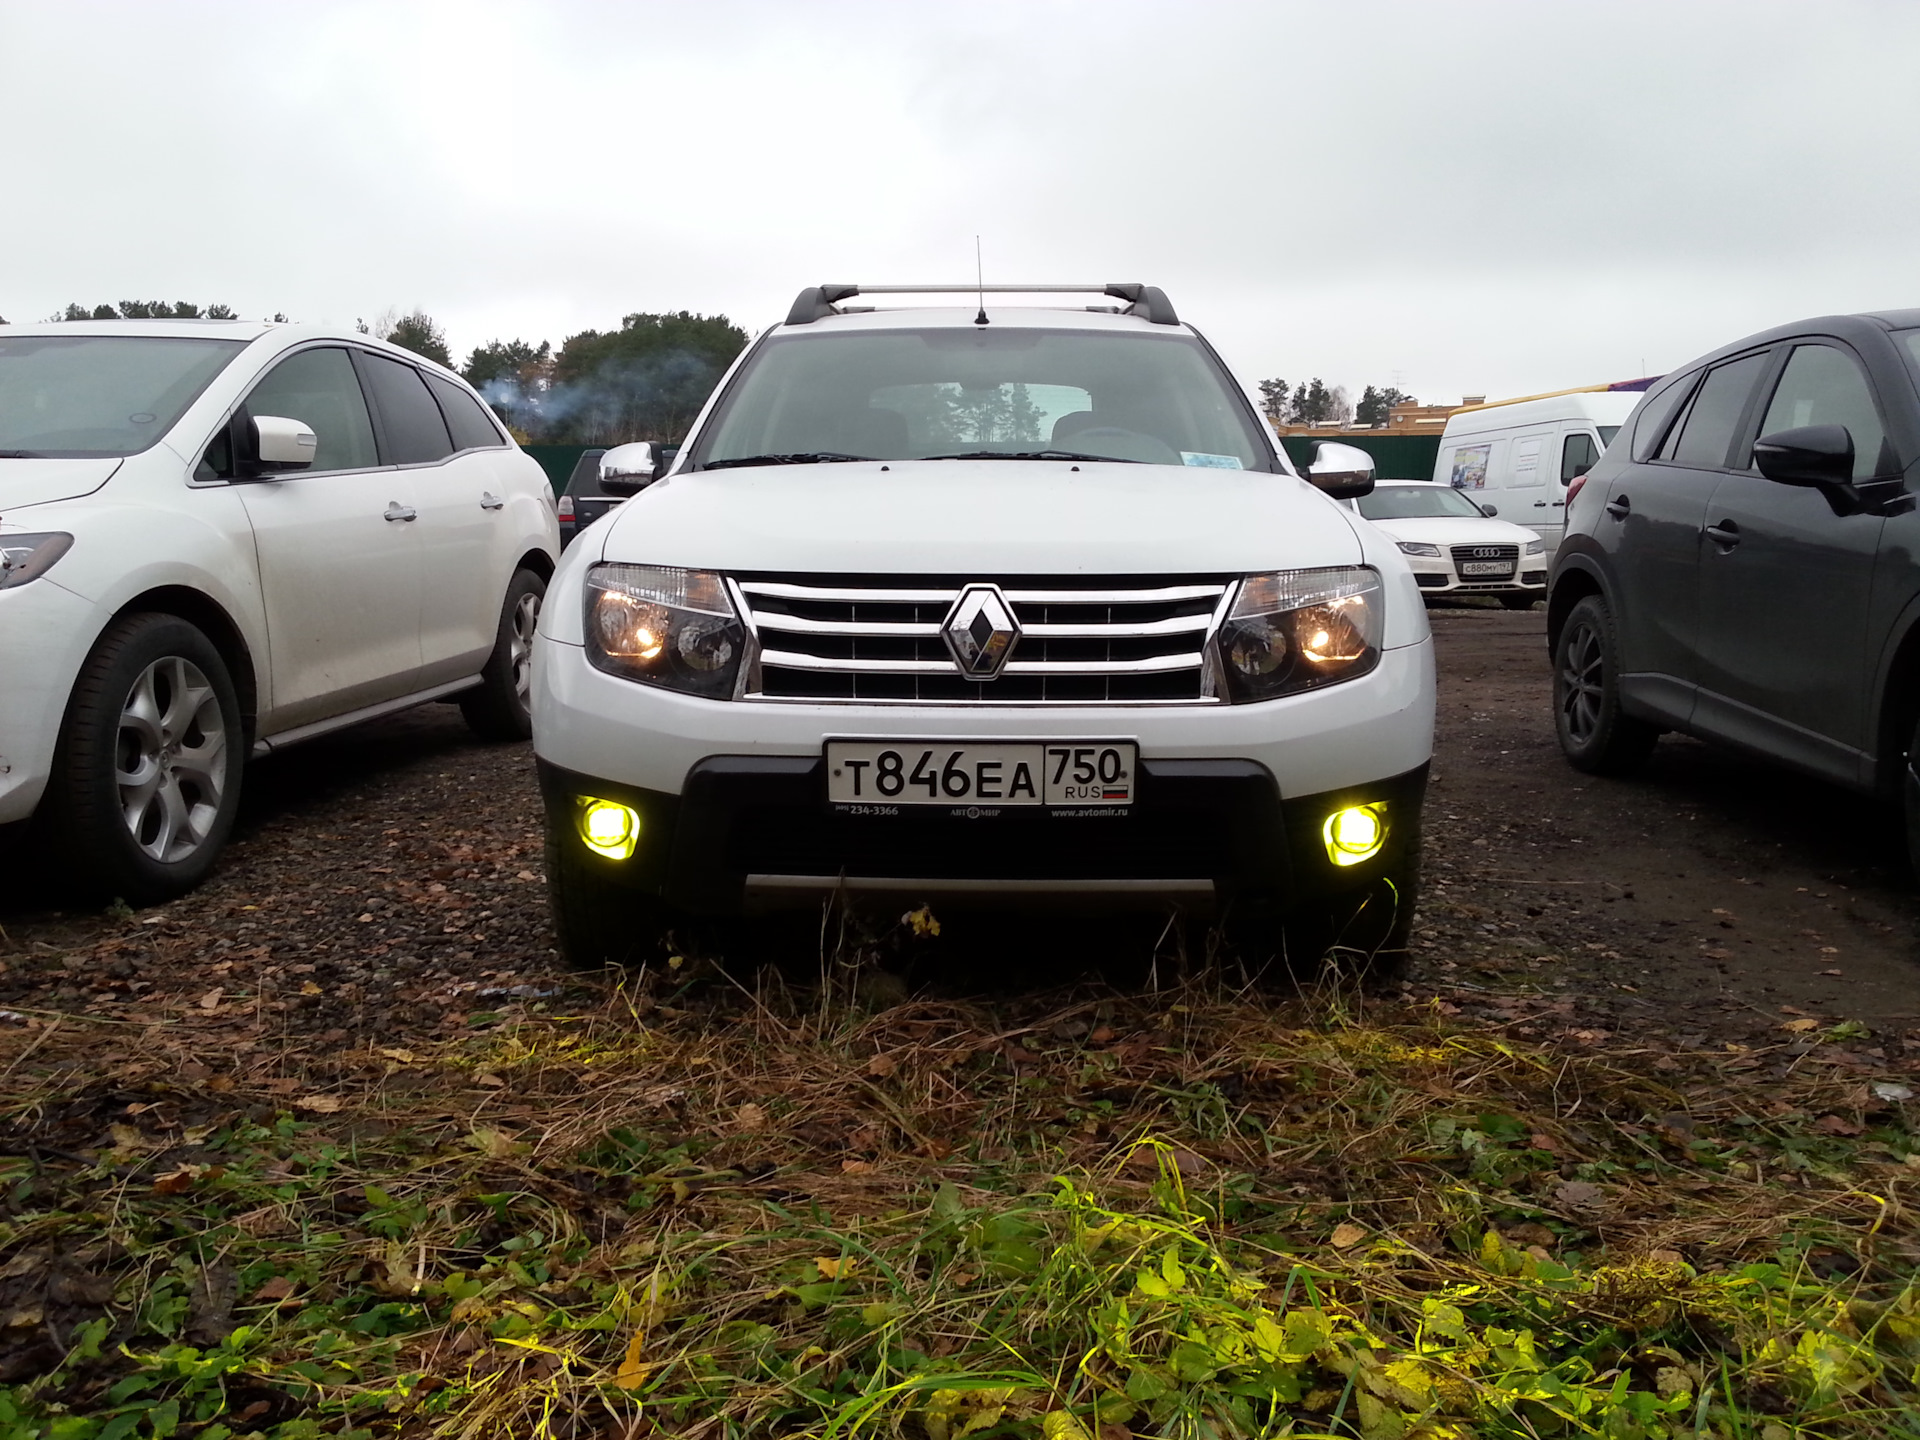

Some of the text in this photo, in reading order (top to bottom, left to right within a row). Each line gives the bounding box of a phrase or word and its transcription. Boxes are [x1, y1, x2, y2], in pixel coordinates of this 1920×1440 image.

[844, 749, 1121, 798] T846EA 750
[1065, 786, 1100, 799] RUS
[850, 805, 899, 815] 234-3366
[1051, 808, 1128, 817] www.avtomir.ru
